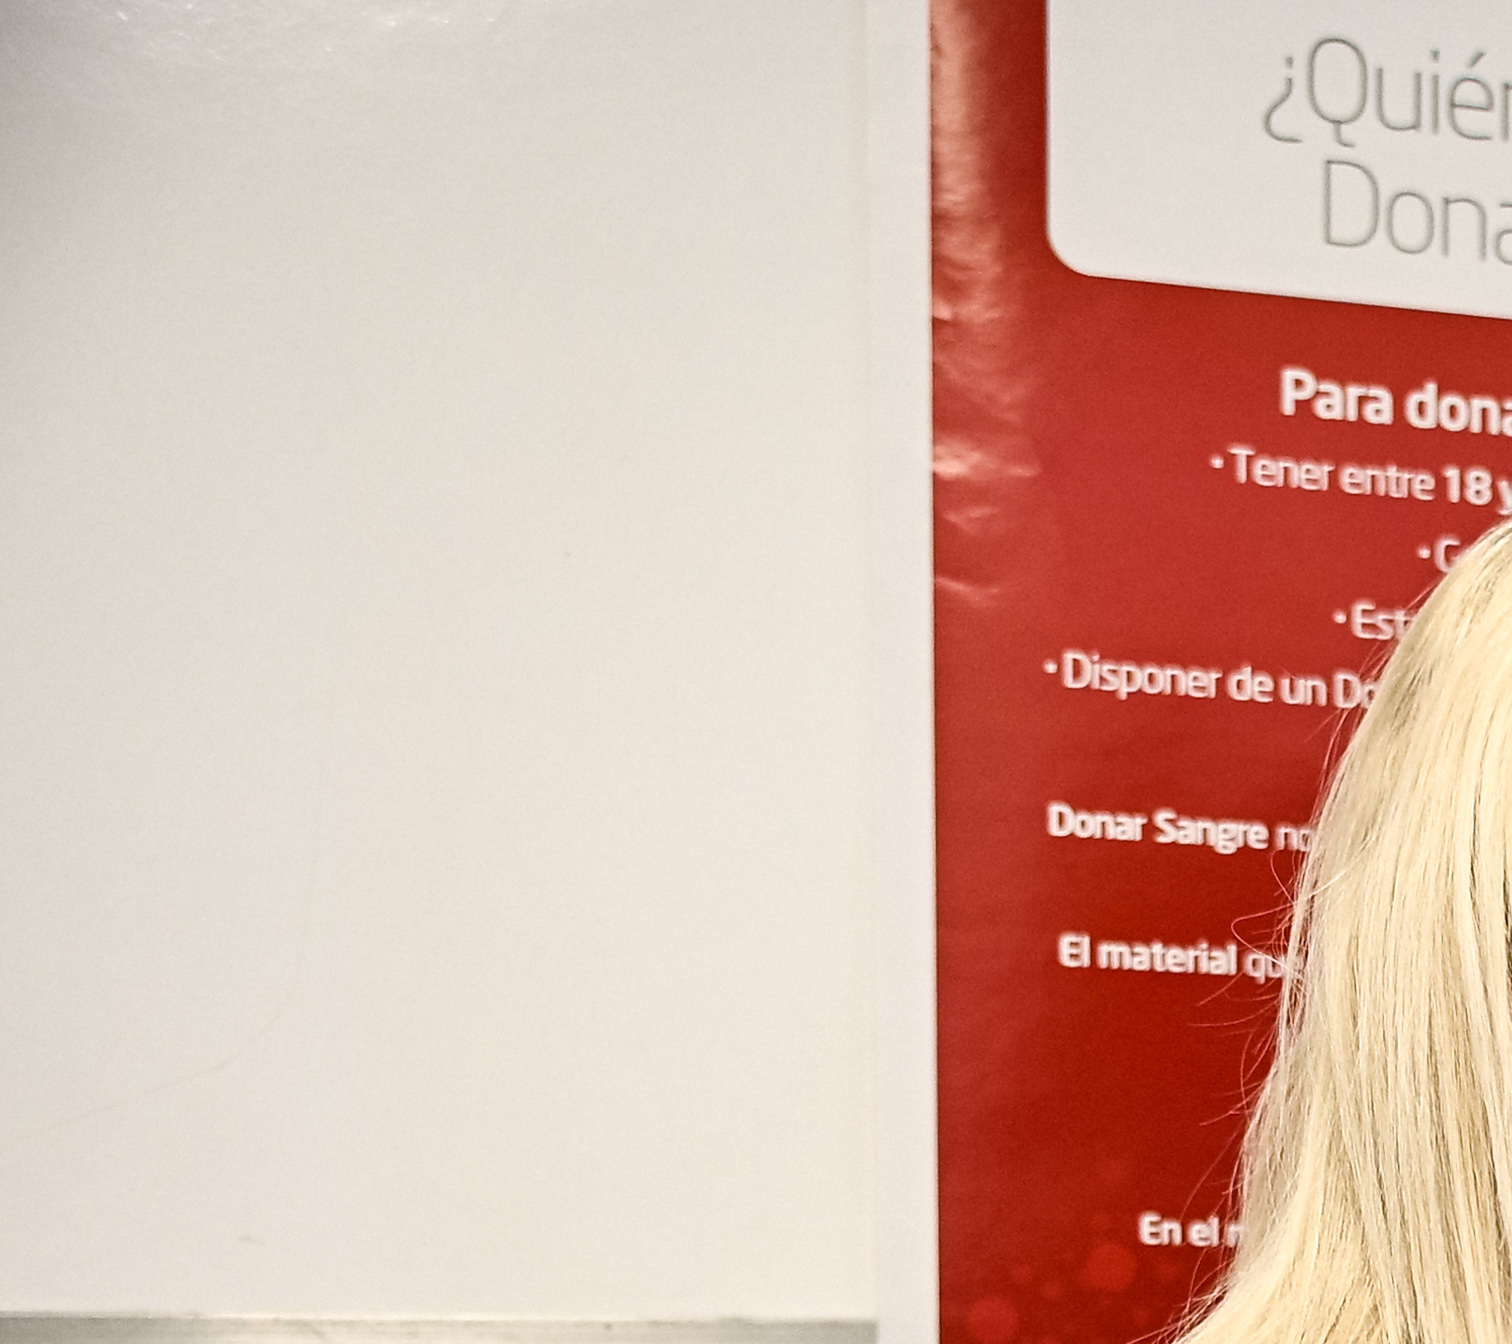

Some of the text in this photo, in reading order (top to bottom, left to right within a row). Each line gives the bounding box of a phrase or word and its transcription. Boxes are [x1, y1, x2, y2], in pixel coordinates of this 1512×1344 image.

[1280, 367, 1394, 425] Para
[1227, 443, 1335, 492] Tener
[1339, 464, 1436, 501] entre
[1444, 464, 1494, 506] 18
[1061, 648, 1222, 700] Disponer
[1227, 664, 1275, 703] de
[1280, 674, 1328, 707] un
[1046, 801, 1148, 842] Donar
[1152, 806, 1270, 854] Sangre
[1057, 930, 1092, 969] El
[1097, 938, 1238, 976] material
[1136, 1211, 1183, 1247] En
[1187, 1214, 1220, 1247] el
